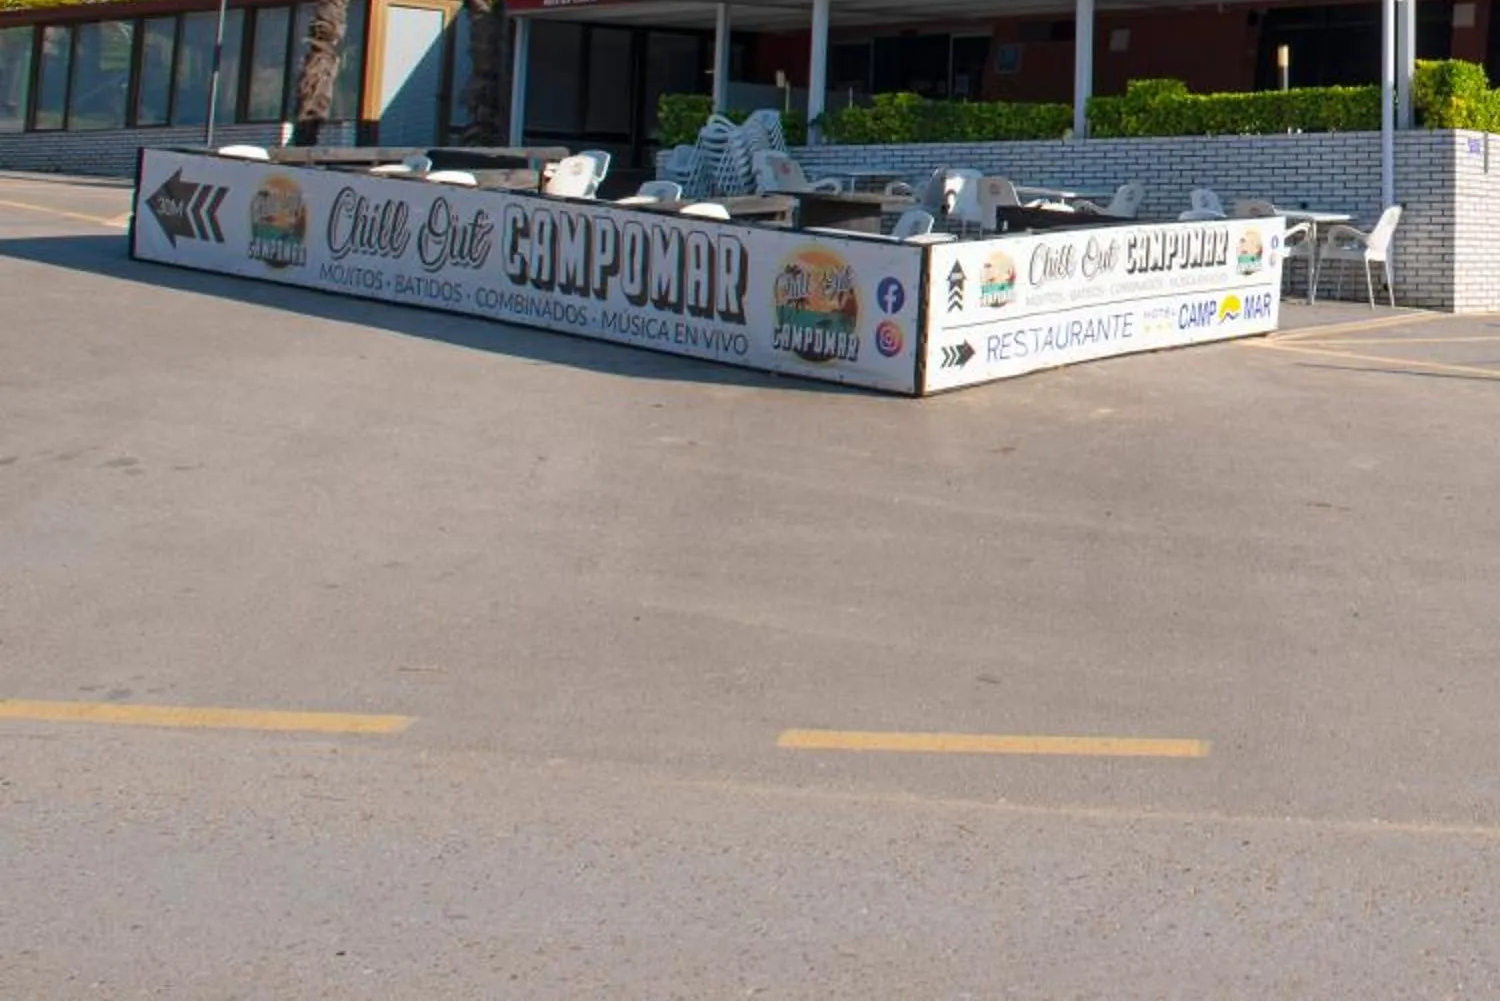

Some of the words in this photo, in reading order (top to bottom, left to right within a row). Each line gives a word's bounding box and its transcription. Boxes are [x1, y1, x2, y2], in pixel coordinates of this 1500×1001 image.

[327, 186, 411, 260] Chill
[418, 196, 494, 273] Out
[502, 203, 749, 326] CAMPOMAR
[1029, 242, 1078, 287] Chill
[1081, 235, 1121, 280] Out
[1125, 225, 1229, 274] CAMPOMAR
[319, 263, 384, 290] MOJITOS
[394, 274, 463, 303] BATIDOS
[475, 287, 588, 326] COMBINADOS
[601, 309, 670, 342] MÚSICA
[674, 323, 699, 346] EN
[702, 329, 749, 356] VIVO
[986, 311, 1135, 362] RESTAURANTE
[771, 322, 861, 362] CAMPOMAR
